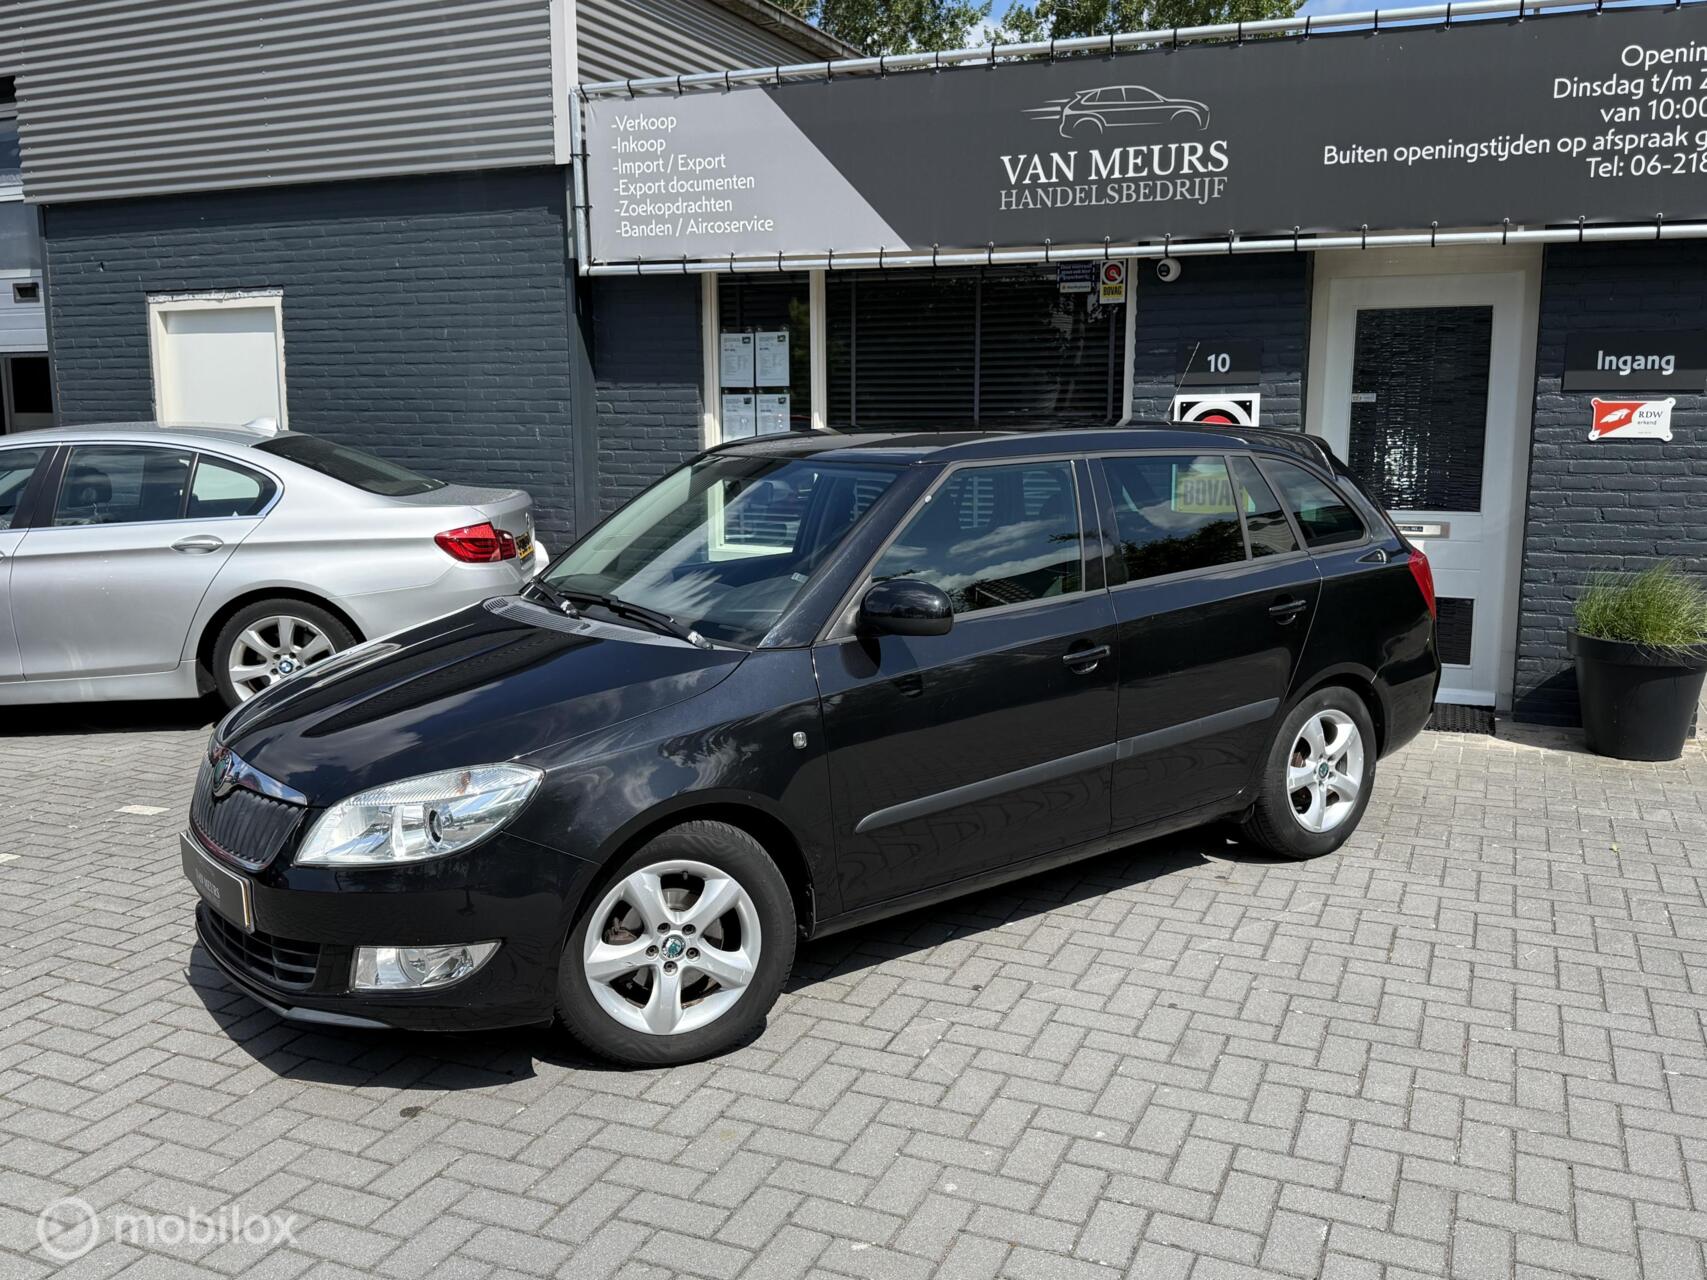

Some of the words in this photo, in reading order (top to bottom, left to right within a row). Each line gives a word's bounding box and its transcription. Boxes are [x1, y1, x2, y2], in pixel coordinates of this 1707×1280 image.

[1621, 41, 1707, 71] Openin
[1553, 73, 1645, 100] Dinsdag
[1651, 69, 1692, 95] t/m
[611, 113, 677, 132] -Verkoop
[1600, 106, 1641, 123] van
[611, 135, 666, 155] -Inkoop
[1324, 145, 1388, 165] Buiten
[1394, 134, 1550, 166] openingstijden
[1557, 135, 1587, 157] op
[1592, 125, 1689, 155] afspraak
[612, 157, 664, 178] -Import
[678, 153, 726, 174] Export
[1000, 151, 1078, 185] VAN
[1088, 140, 1229, 180] MEURS
[1586, 155, 1624, 178] Tel:
[613, 178, 666, 198] -Export
[668, 174, 755, 193] documenten
[1000, 177, 1228, 210] HANDELSBEDRIJF
[614, 196, 732, 218] -Zoekopdrachten
[615, 219, 672, 238] -Banden
[686, 216, 774, 235] Aircoservice
[1207, 353, 1231, 373] 10
[1597, 350, 1675, 376] Ingang
[1638, 410, 1663, 418] RDW
